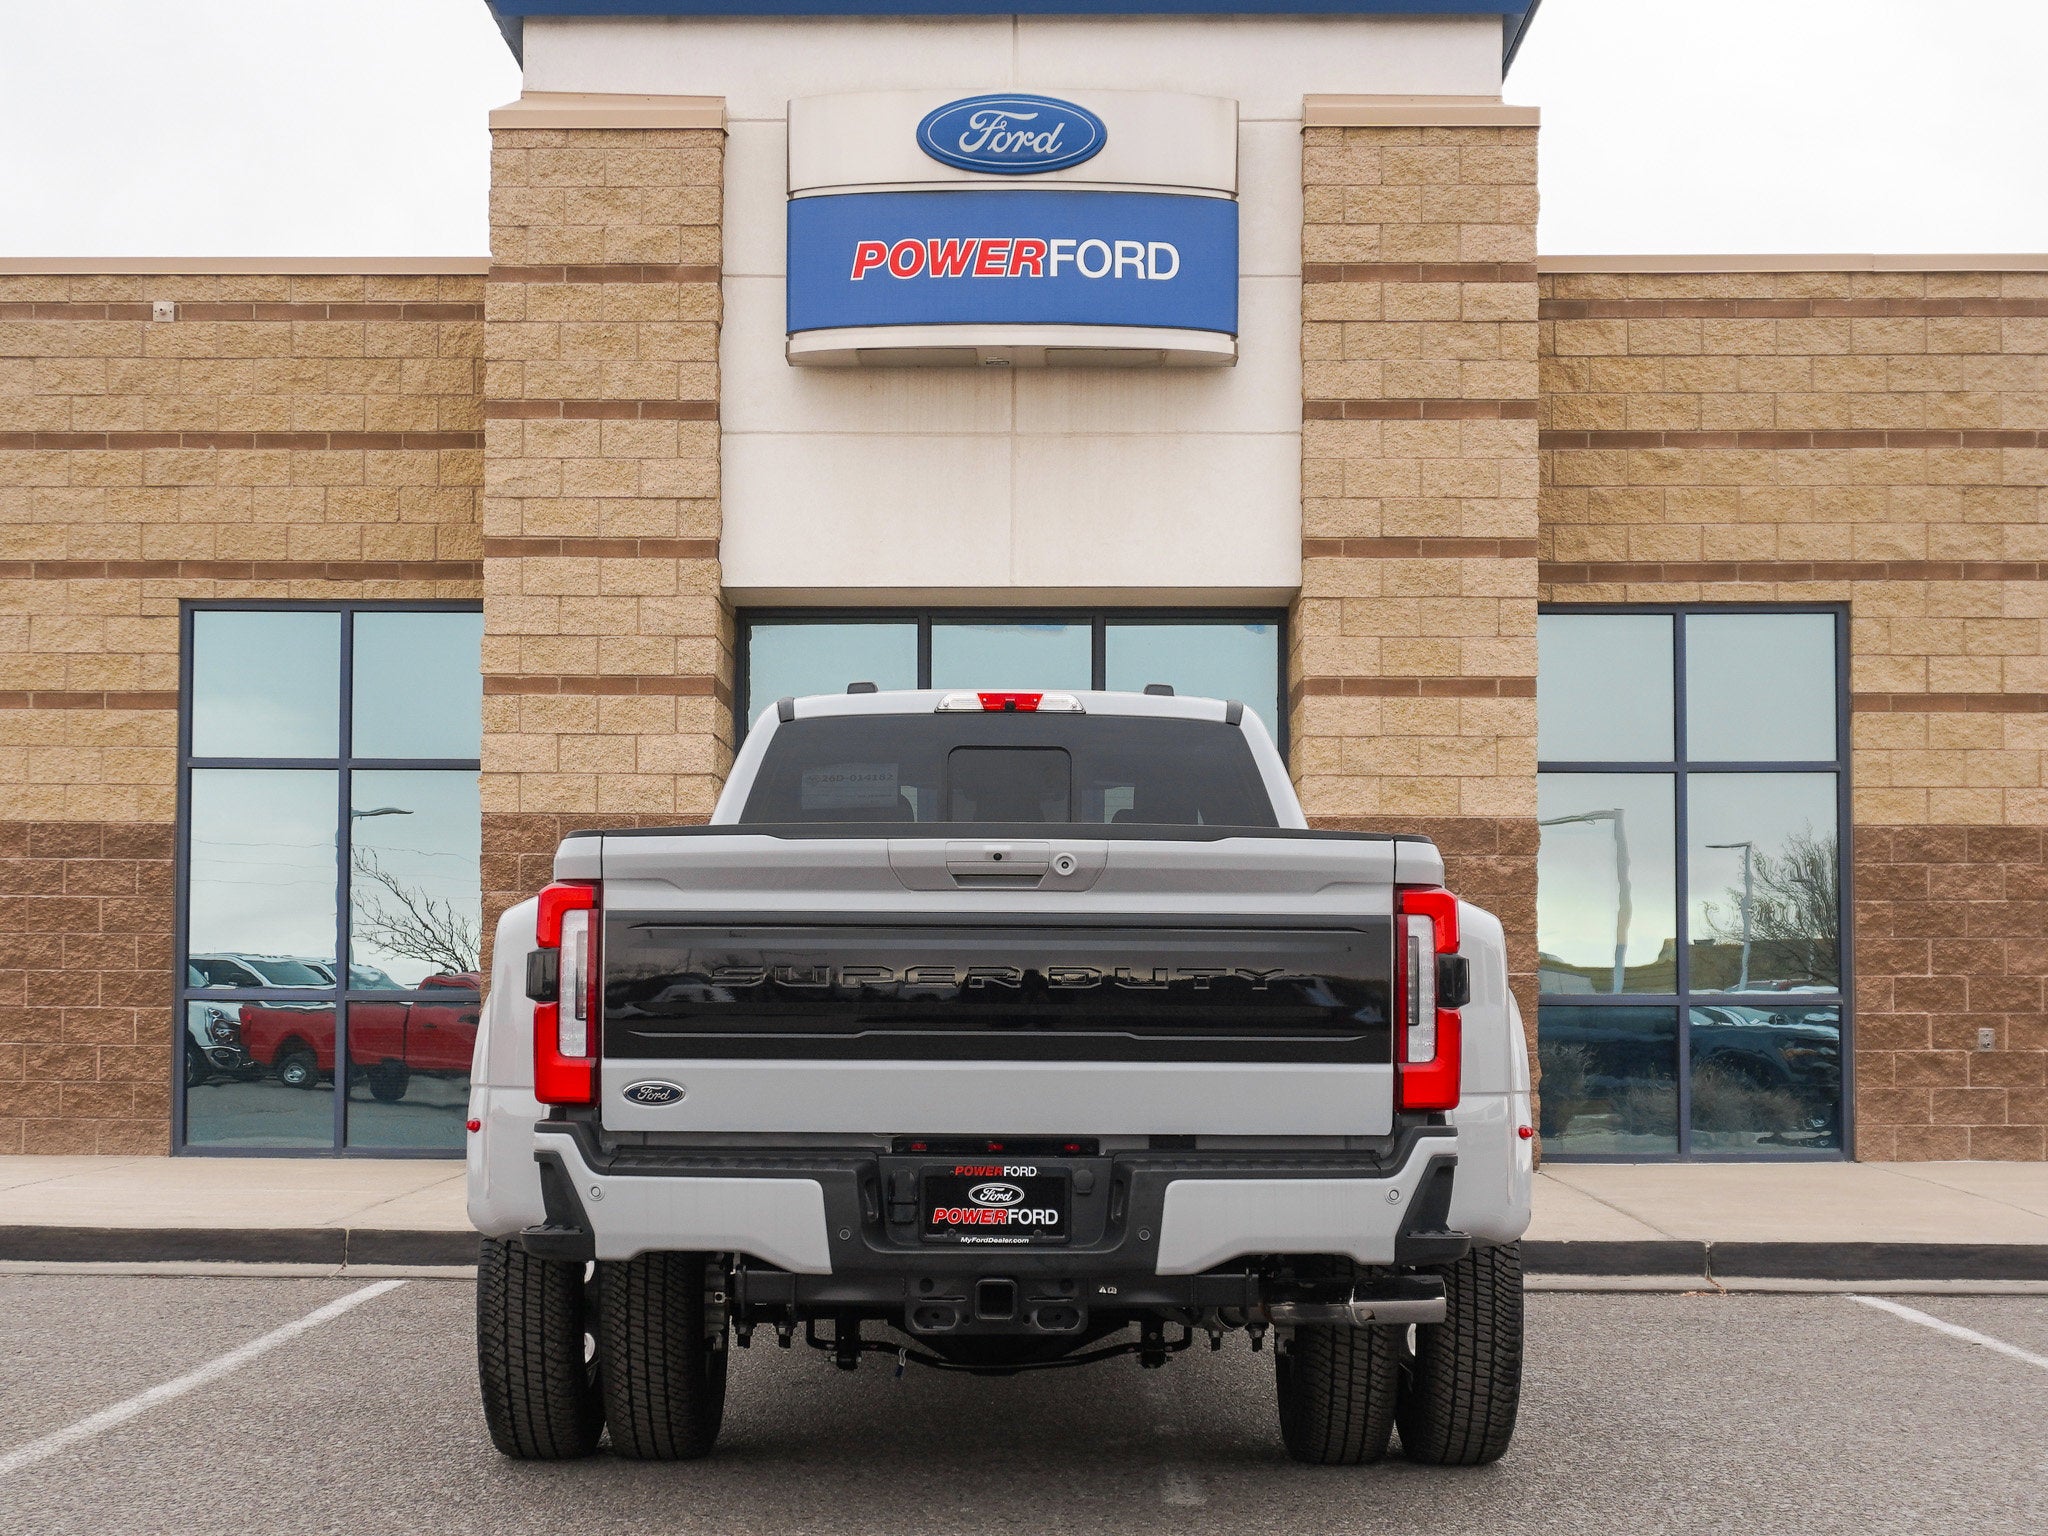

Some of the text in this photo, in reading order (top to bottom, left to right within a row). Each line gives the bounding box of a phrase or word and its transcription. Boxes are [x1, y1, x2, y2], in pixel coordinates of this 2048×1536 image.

[958, 109, 1065, 155] Ford
[850, 238, 1181, 281] POWERFORD
[710, 964, 1285, 991] SUPER DUTY
[637, 1085, 671, 1100] Ford
[954, 1166, 1037, 1177] POWERFORD
[979, 1187, 1013, 1202] Ford
[932, 1207, 1059, 1225] POWERFORD
[960, 1236, 1030, 1244] MyFordDealer.com
